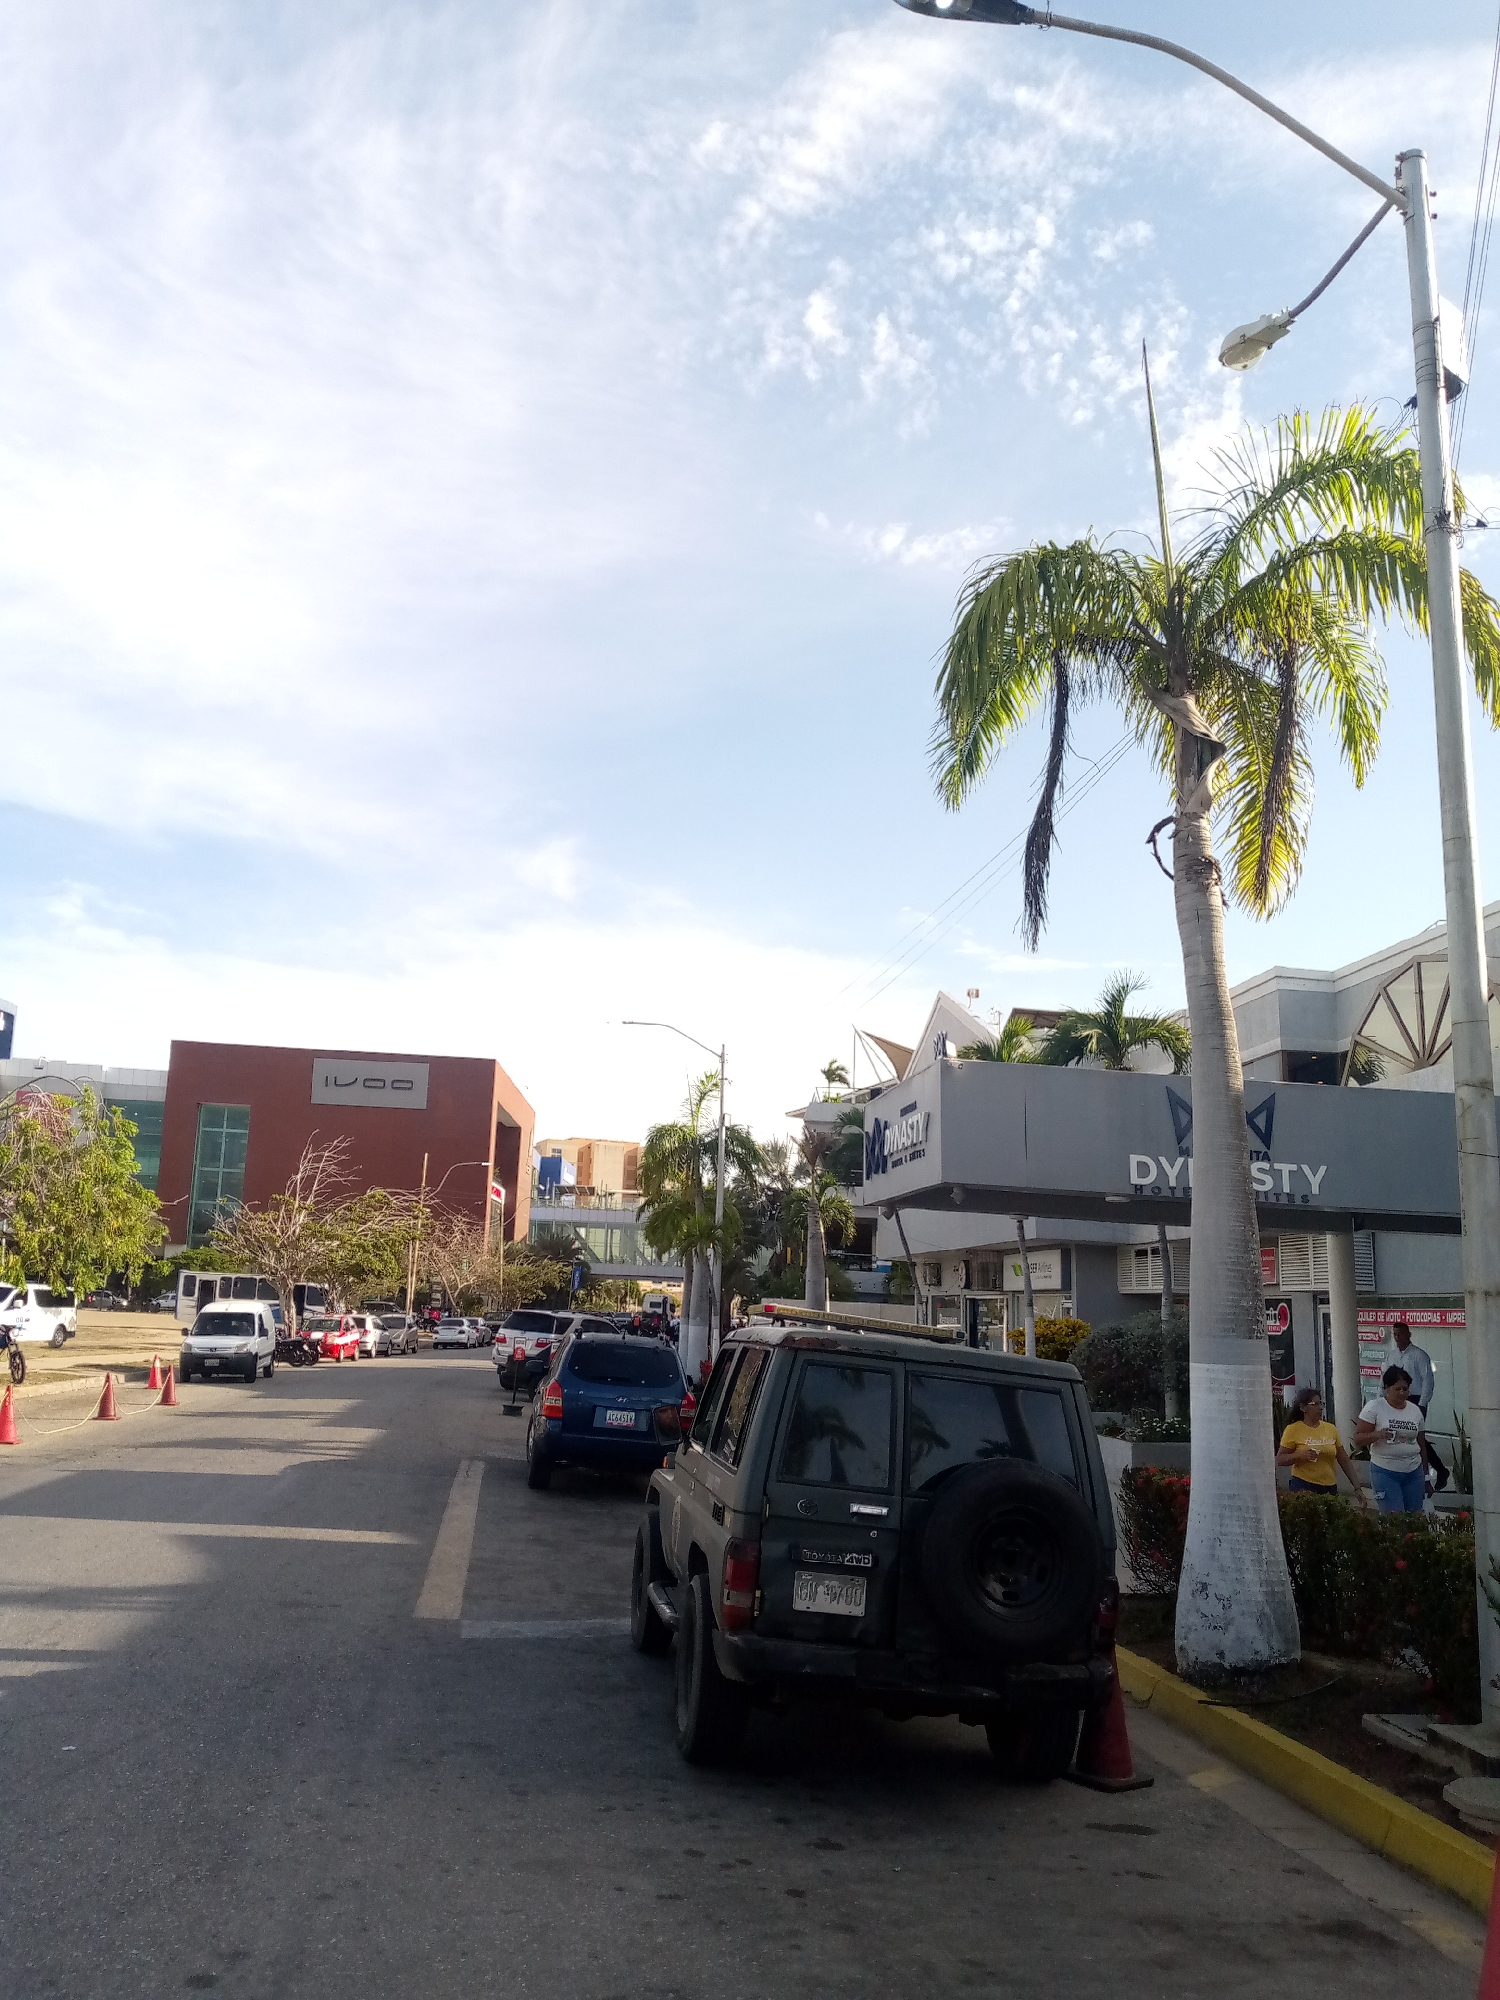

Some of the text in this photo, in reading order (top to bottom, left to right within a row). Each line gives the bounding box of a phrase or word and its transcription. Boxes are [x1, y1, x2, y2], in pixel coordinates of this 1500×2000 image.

[883, 1111, 925, 1156] DYNASTY
[1129, 1154, 1328, 1195] DYSTY
[1134, 1185, 1193, 1199] HOTE
[1357, 1311, 1376, 1322] QUILER
[1406, 1312, 1440, 1322] FOTOCOPIAS
[1446, 1312, 1465, 1322] IMPRE
[805, 1551, 871, 1566] TOYOTA 4WD
